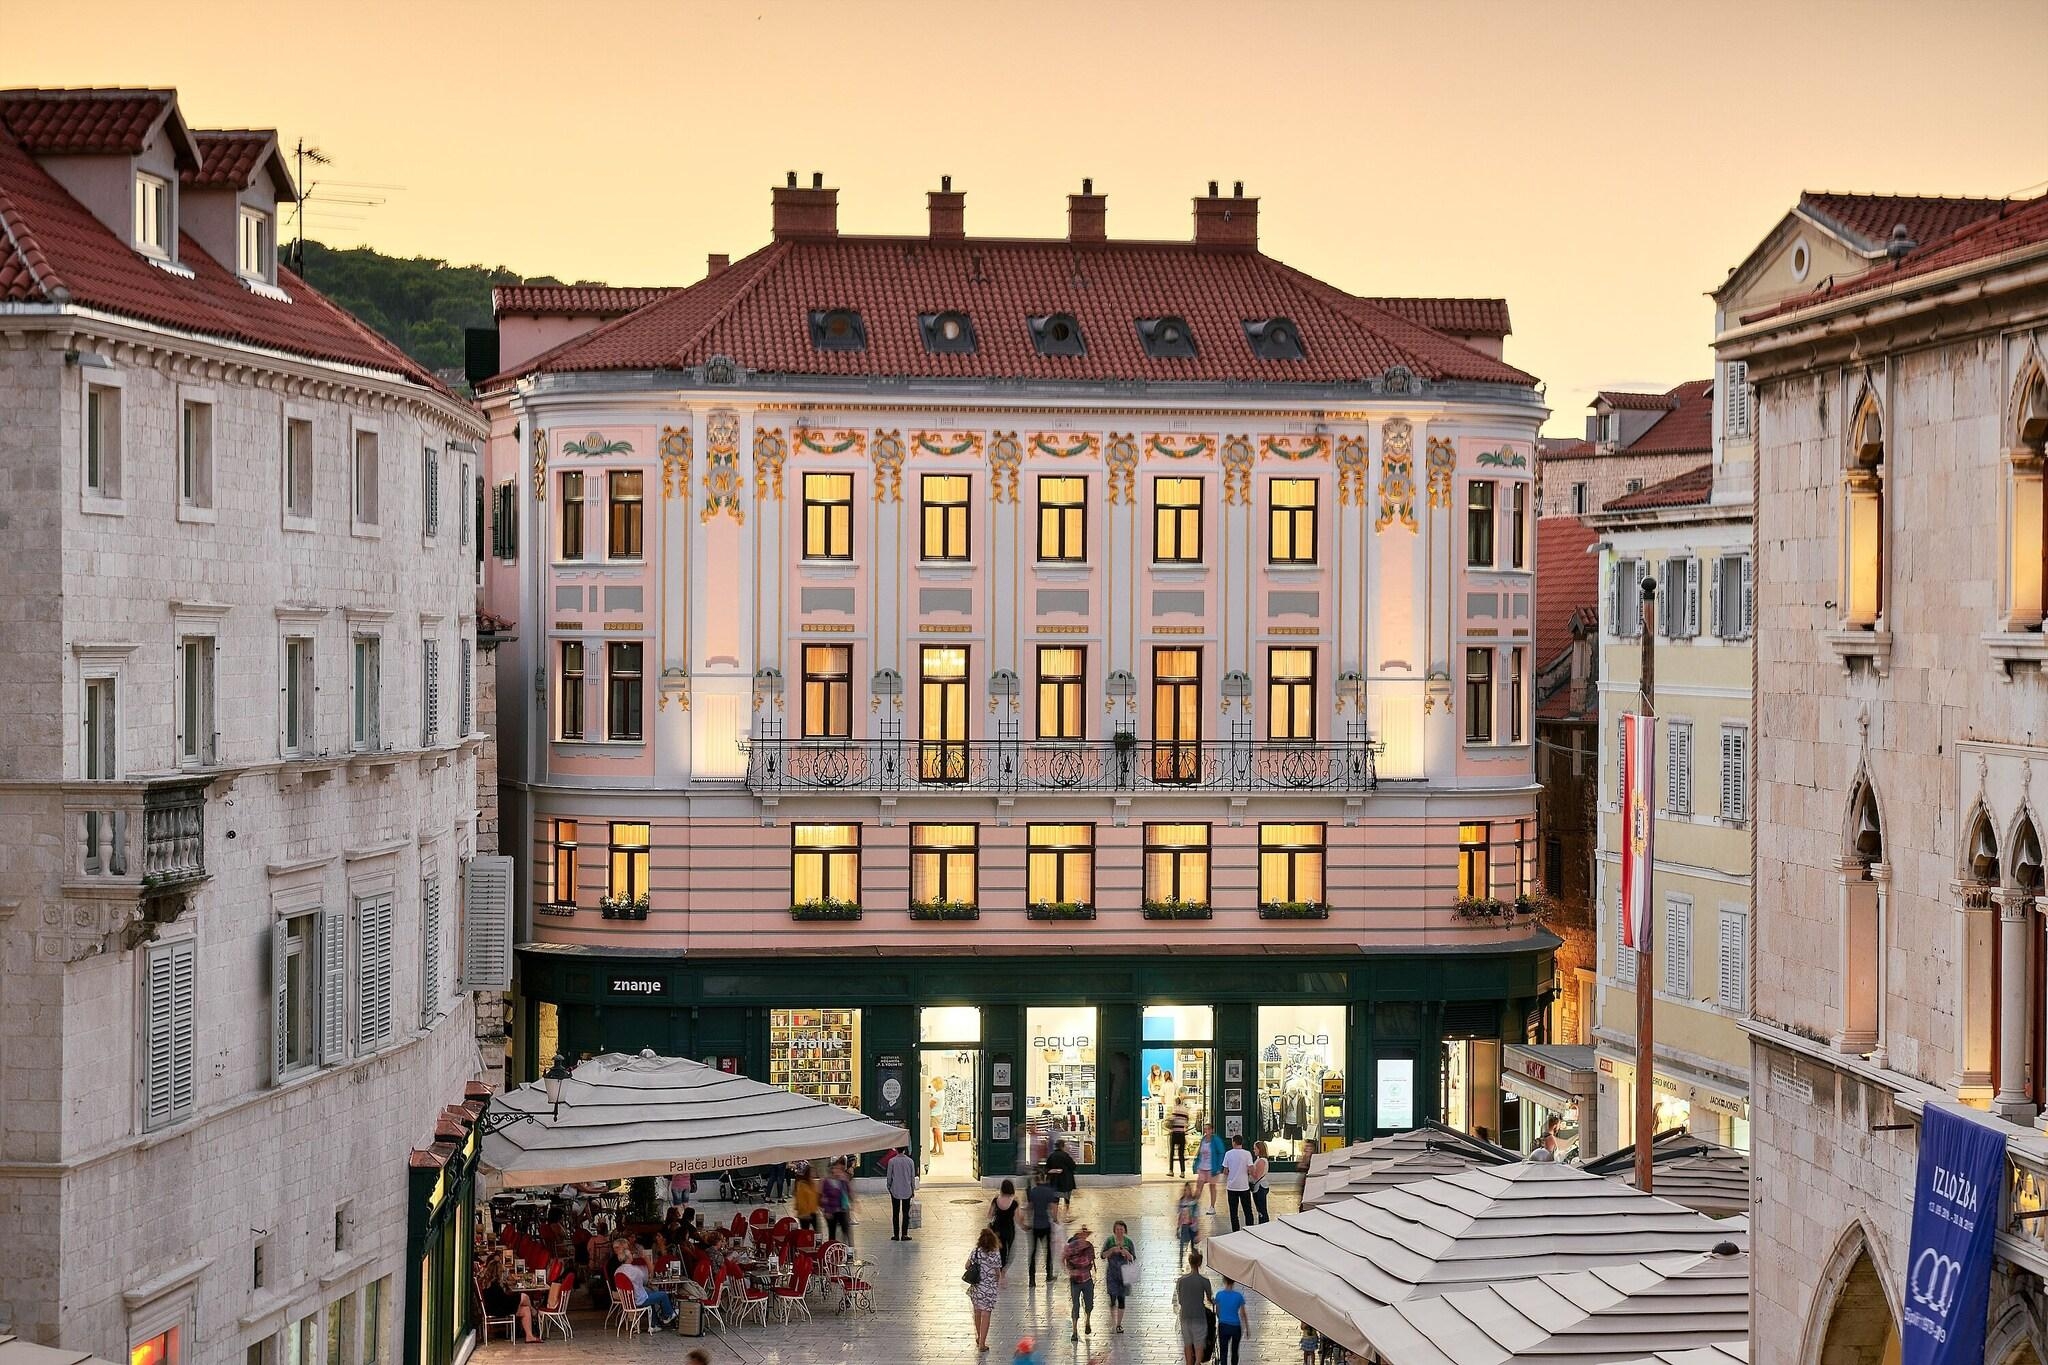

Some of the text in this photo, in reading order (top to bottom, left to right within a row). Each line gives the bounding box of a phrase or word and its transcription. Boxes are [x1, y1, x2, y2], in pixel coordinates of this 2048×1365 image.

[613, 980, 662, 994] znanje
[1033, 1035, 1089, 1050] aqua
[1274, 1034, 1329, 1048] aqua
[669, 1155, 748, 1172] Palača Judita
[1932, 1165, 1977, 1213] IZLOŽBA
